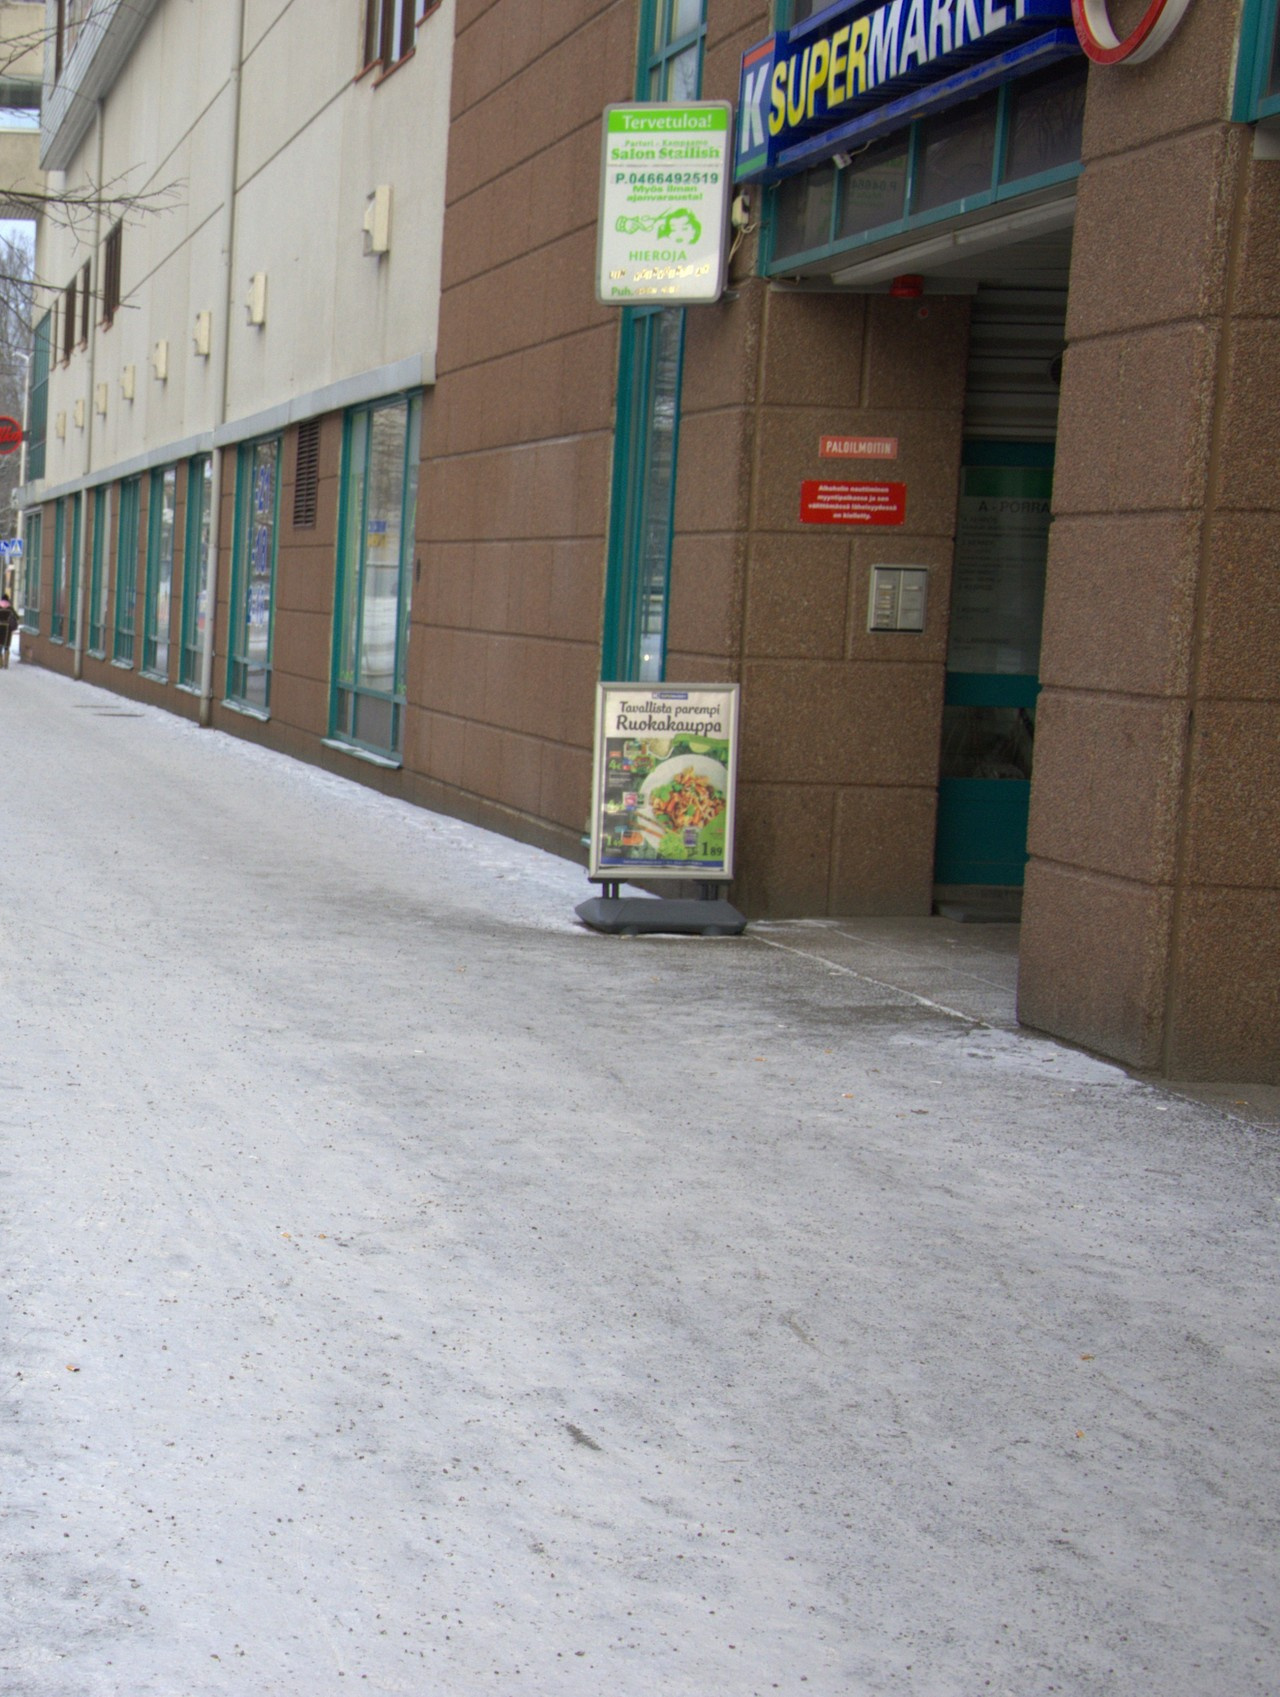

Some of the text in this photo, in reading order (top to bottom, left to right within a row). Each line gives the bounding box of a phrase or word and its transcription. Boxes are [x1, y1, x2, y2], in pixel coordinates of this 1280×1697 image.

[740, 0, 1026, 154] K SUPERMARKE
[622, 113, 713, 130] Tervetuloa!
[611, 147, 656, 160] Salon
[615, 172, 719, 185] P.0466492519
[628, 250, 688, 261] HIEROJA
[825, 440, 892, 455] PALOILMOITIN
[620, 700, 720, 717] Tavallista parempi
[616, 714, 722, 738] Ruokakauppa
